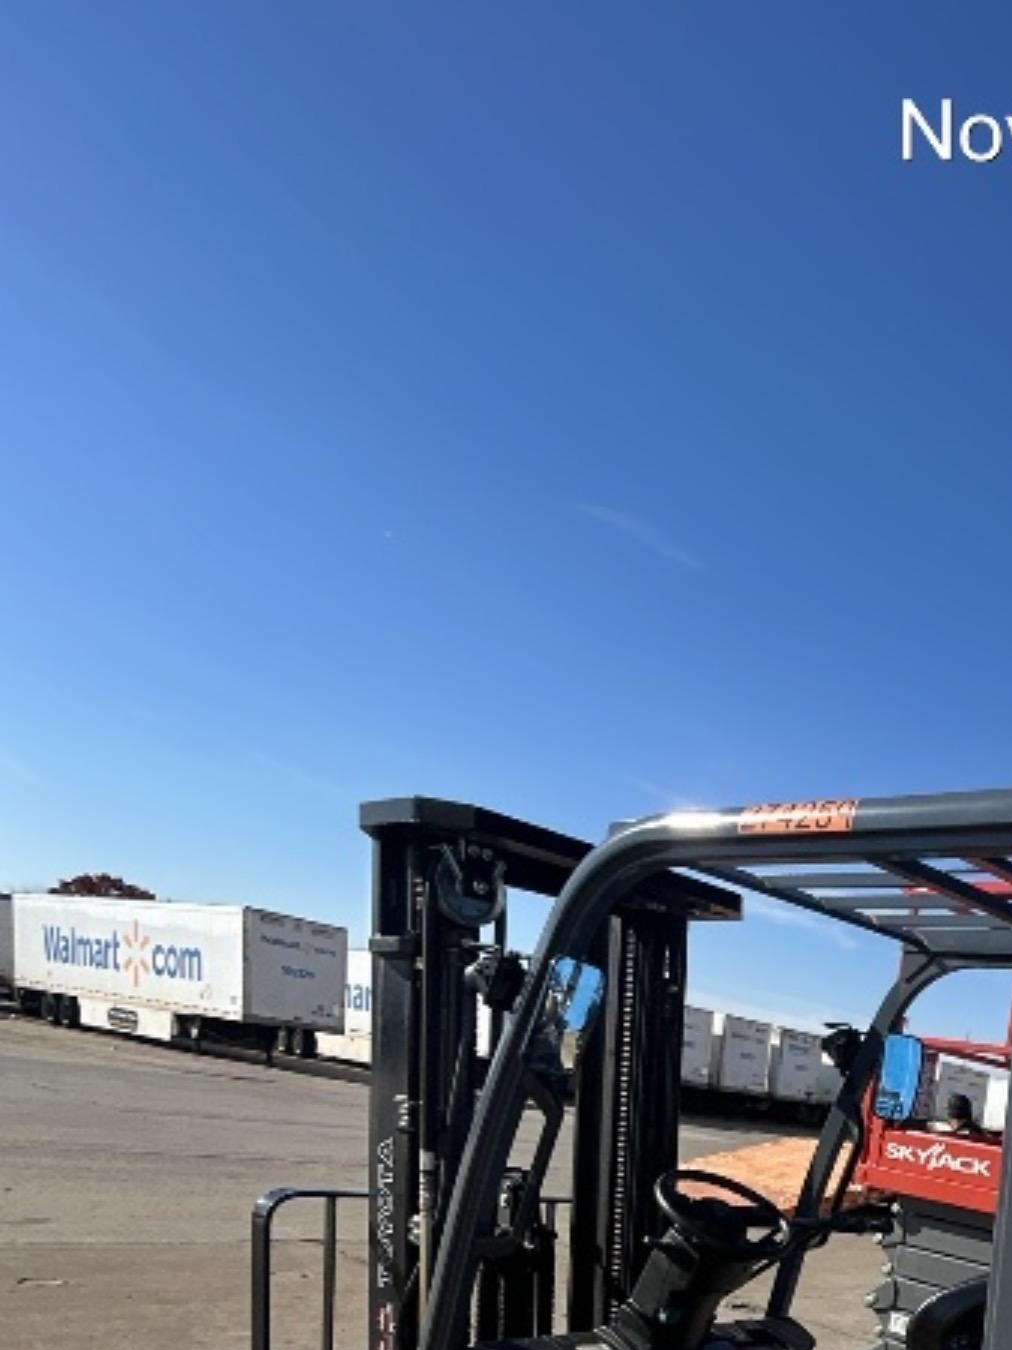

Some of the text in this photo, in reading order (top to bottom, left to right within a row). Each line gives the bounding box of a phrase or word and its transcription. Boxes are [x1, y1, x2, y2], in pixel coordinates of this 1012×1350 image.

[43, 923, 203, 982] Walmart com
[885, 1141, 991, 1177] SKYJACK
[376, 1135, 396, 1289] TOYOTA
